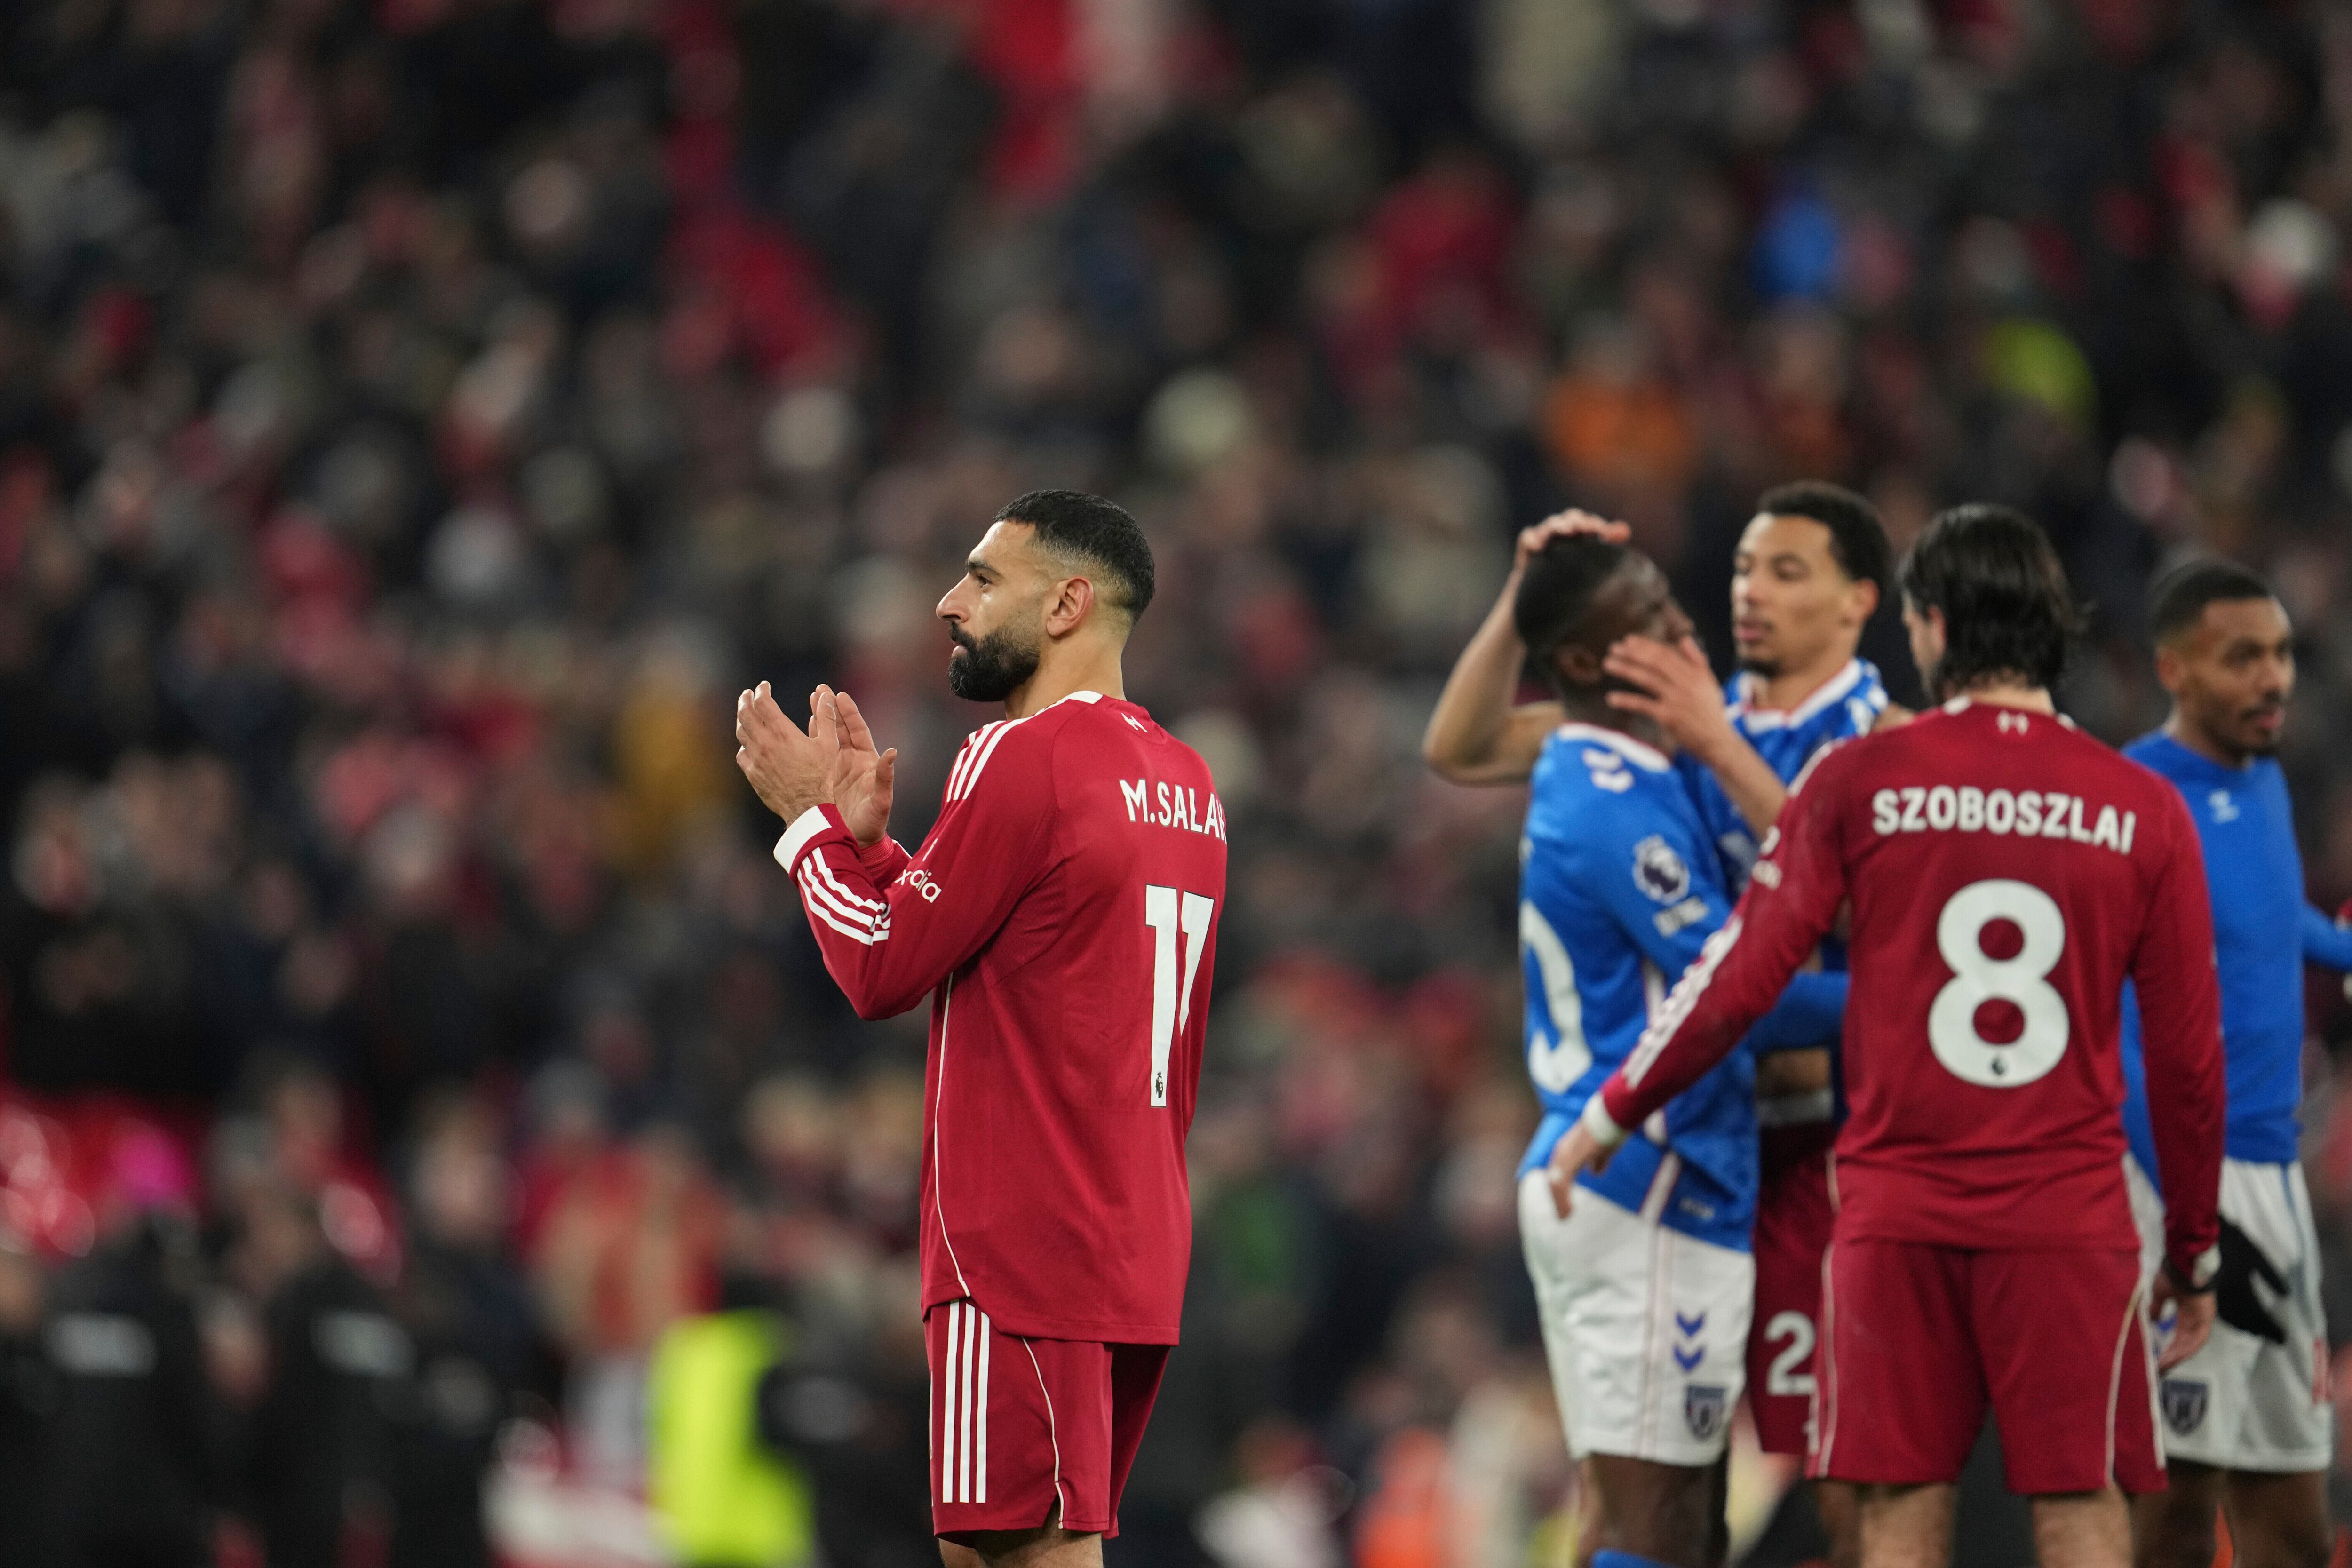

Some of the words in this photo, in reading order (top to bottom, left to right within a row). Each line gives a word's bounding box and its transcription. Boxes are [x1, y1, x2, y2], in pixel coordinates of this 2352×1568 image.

[1872, 785, 2136, 855] SZOBOSZLAI
[1928, 878, 2069, 1088] 8
[1764, 1310, 1818, 1396] 2
